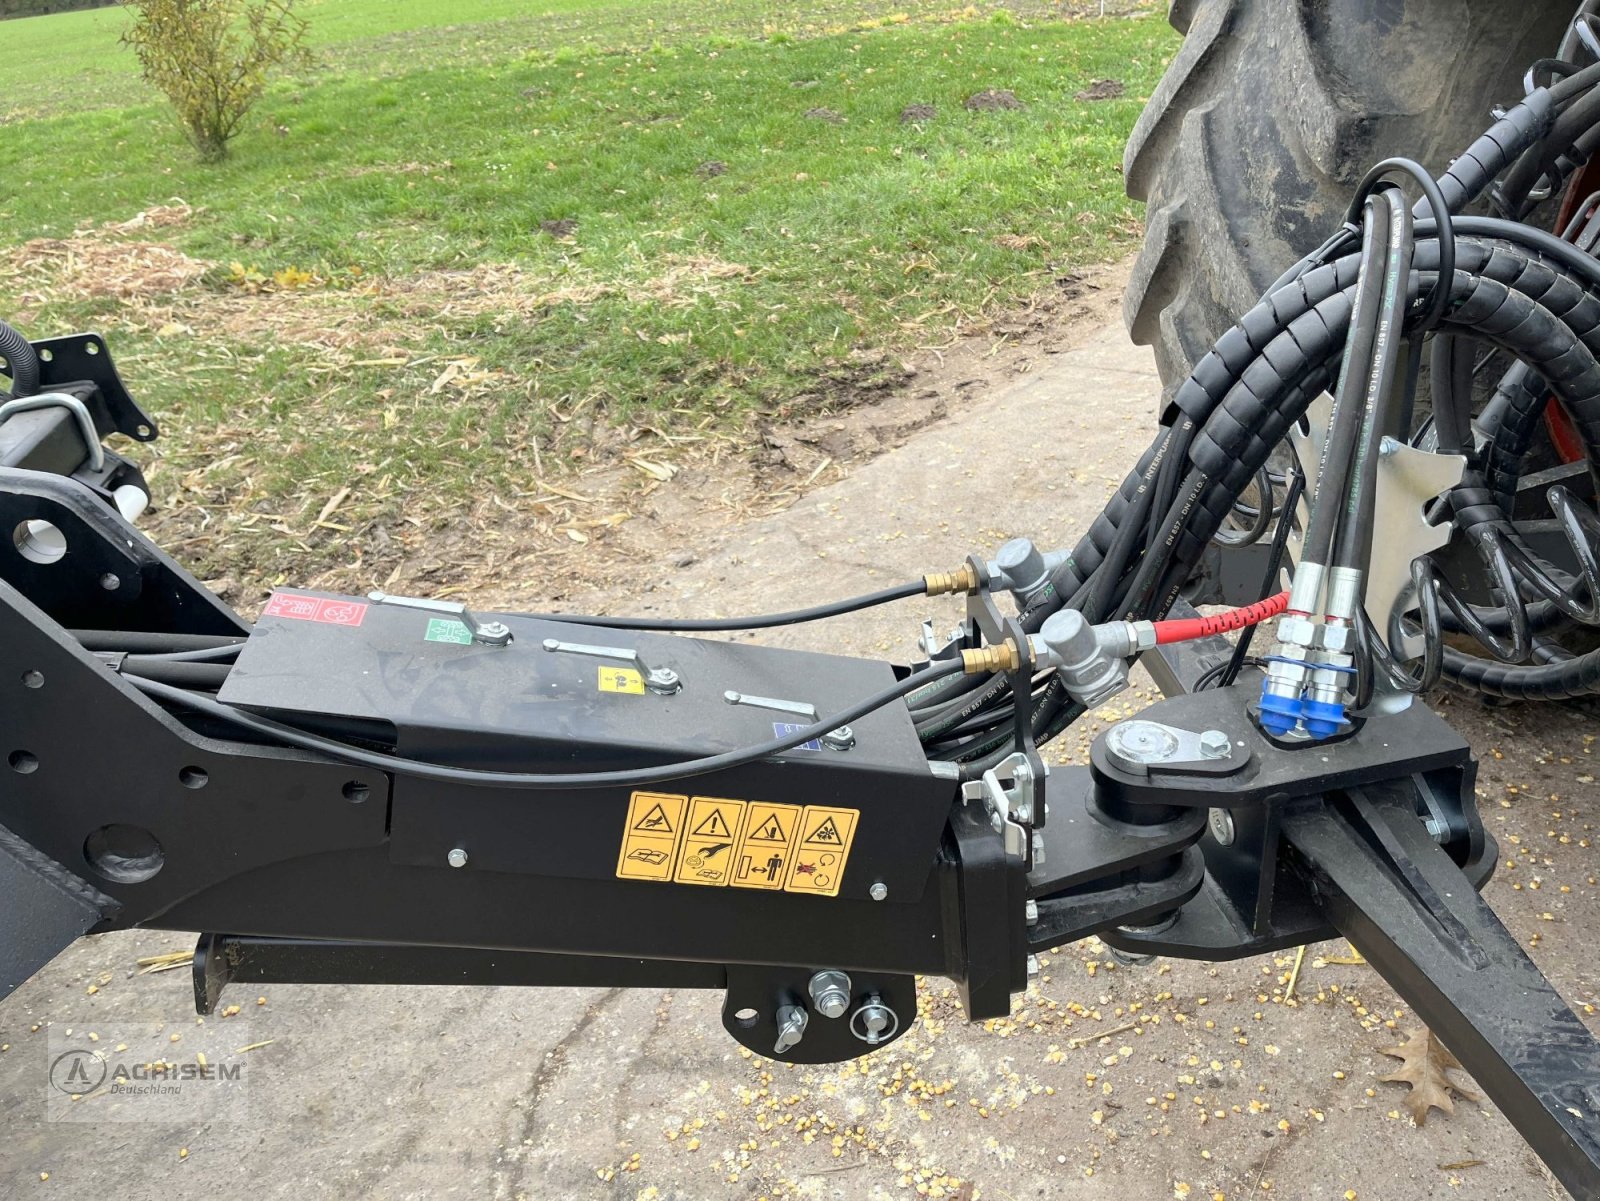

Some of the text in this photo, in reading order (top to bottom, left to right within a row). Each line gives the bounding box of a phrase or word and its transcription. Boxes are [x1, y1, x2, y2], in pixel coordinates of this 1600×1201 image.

[1381, 320, 1388, 331] EN
[1378, 332, 1386, 346] 857
[1375, 354, 1382, 367] DN
[1373, 369, 1379, 378] 10
[1165, 535, 1174, 545] EN
[1171, 521, 1180, 534] 857
[1181, 502, 1191, 515] DN
[1188, 493, 1196, 501] 10
[1193, 481, 1204, 492] I.D.
[1171, 585, 1179, 594] EN
[961, 708, 971, 716] EN
[970, 699, 982, 710] 857
[986, 688, 997, 698] DN
[996, 681, 1004, 689] 10
[1040, 697, 1048, 708] DN
[1046, 689, 1052, 697] 10
